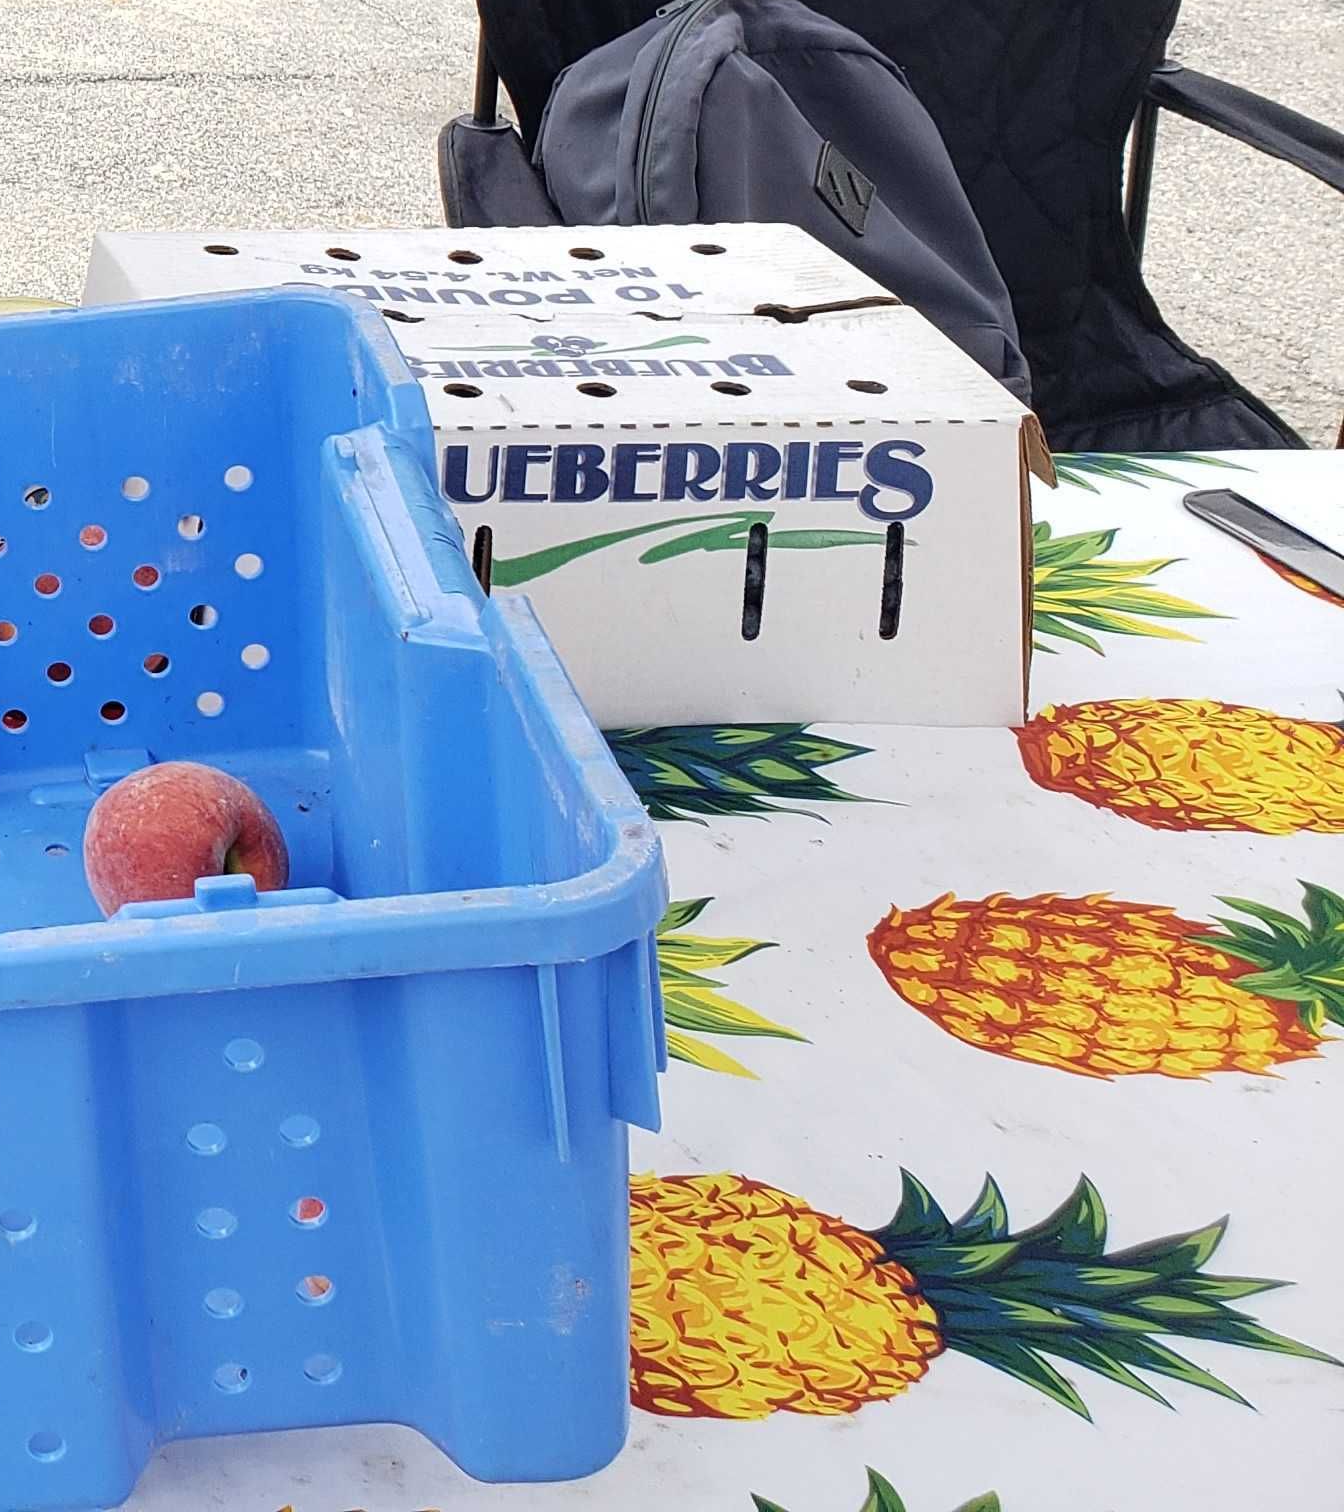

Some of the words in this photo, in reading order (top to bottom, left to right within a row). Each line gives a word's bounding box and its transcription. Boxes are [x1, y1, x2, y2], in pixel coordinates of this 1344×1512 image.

[299, 263, 357, 278] kg
[369, 269, 471, 283] 4.54
[485, 270, 560, 283] Wt.
[572, 266, 658, 281] Net
[282, 282, 595, 306] POUND
[615, 283, 704, 303] 10
[441, 438, 934, 522] UEBERRIES
